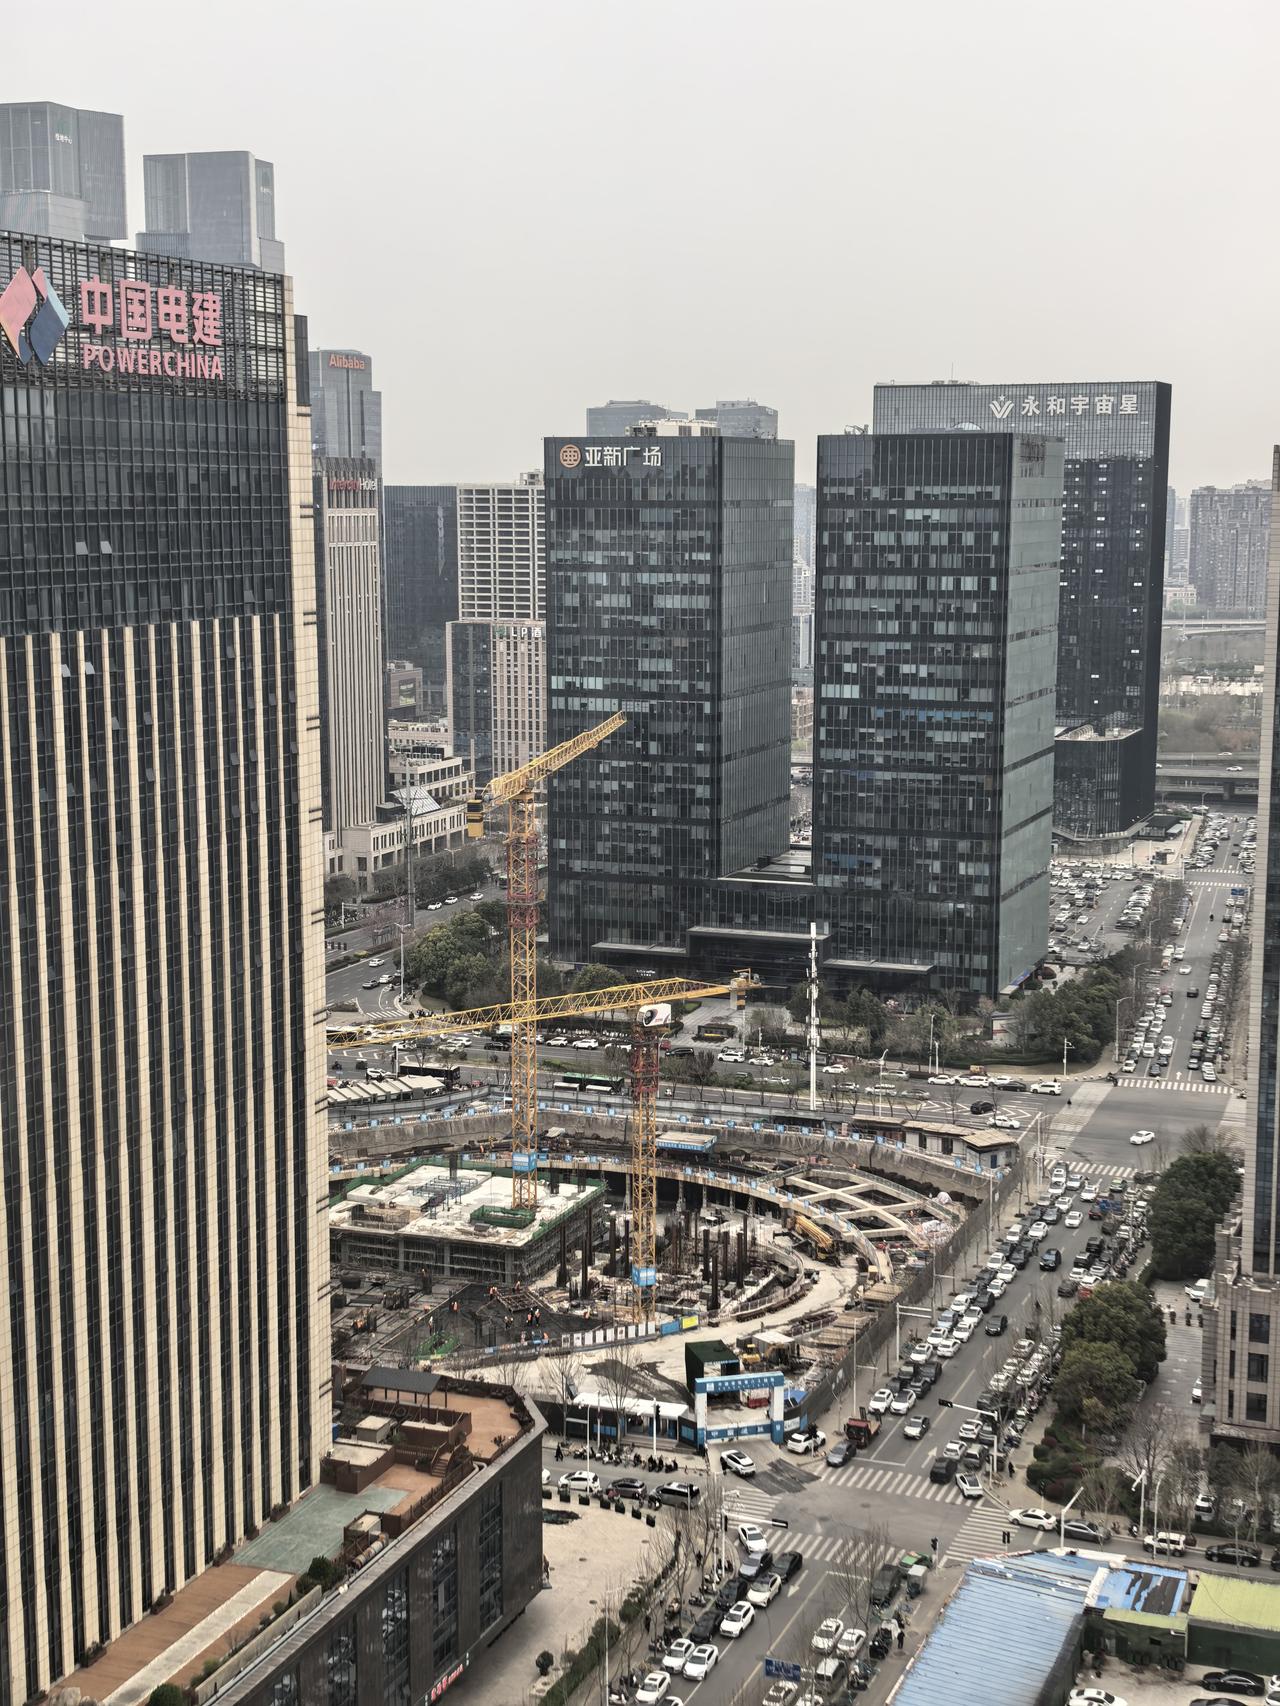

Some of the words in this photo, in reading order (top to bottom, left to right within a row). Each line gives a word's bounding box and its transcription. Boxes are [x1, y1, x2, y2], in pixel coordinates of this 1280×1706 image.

[80, 274, 223, 346] 中国电建
[81, 343, 224, 380] POWERCHINA
[329, 353, 365, 369] Alibaba
[1021, 394, 1138, 416] 永和宇宙星
[584, 446, 662, 467] 亚新广场
